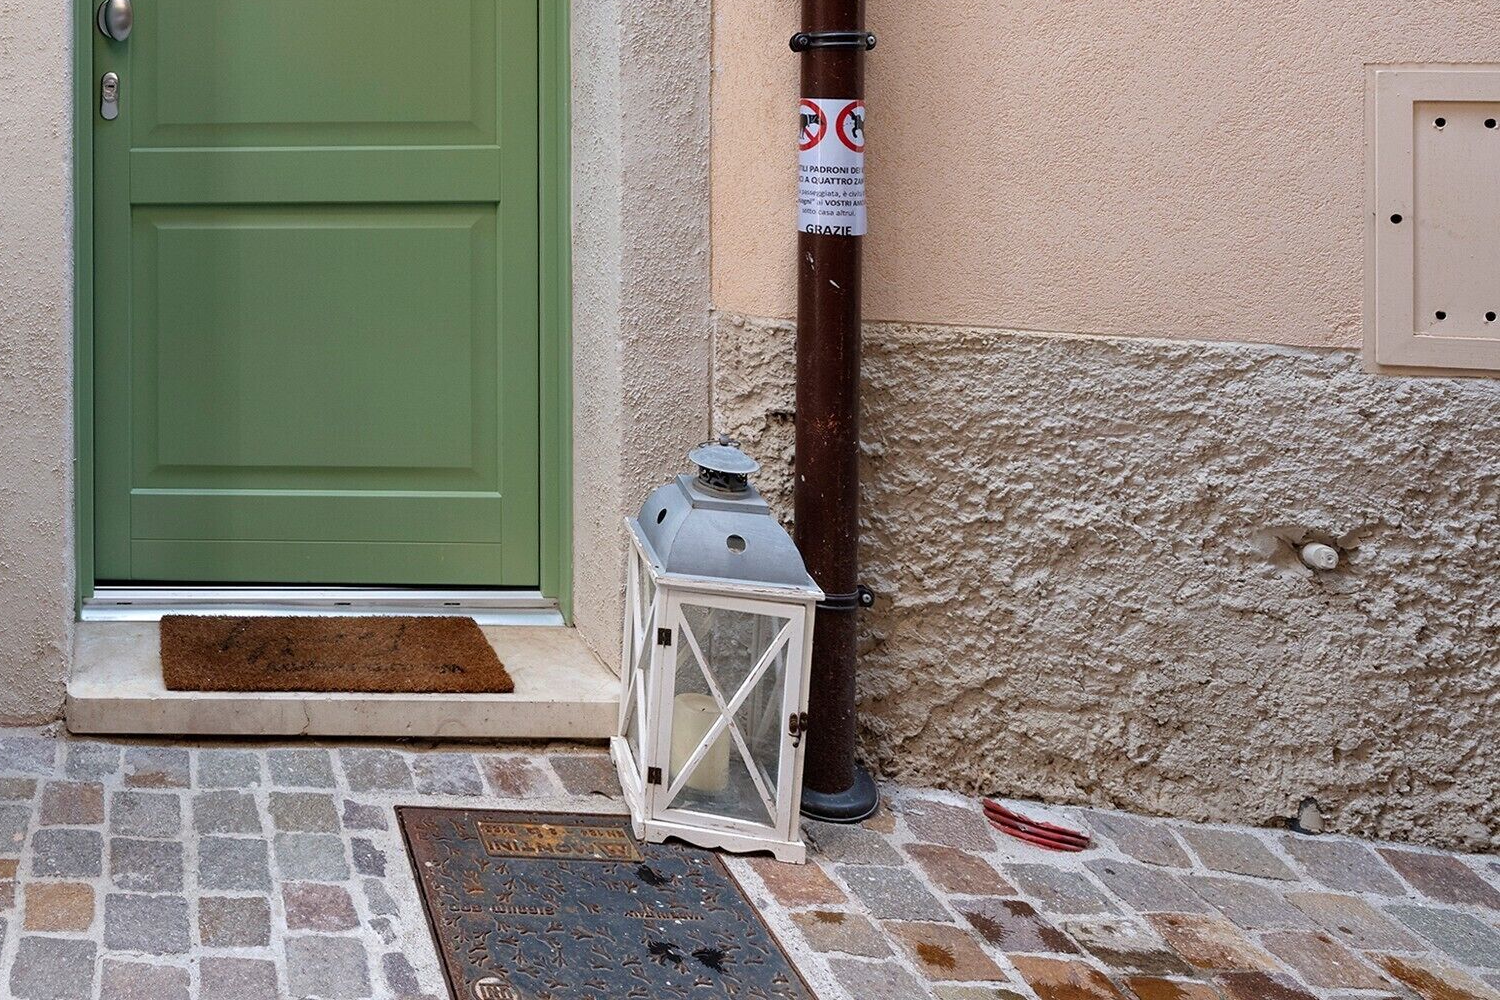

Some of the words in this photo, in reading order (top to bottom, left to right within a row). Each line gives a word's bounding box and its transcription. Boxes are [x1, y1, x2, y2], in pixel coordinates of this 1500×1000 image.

[810, 166, 848, 174] PADRONI
[811, 177, 853, 185] QUATTRO
[806, 224, 852, 236] GRAZIE
